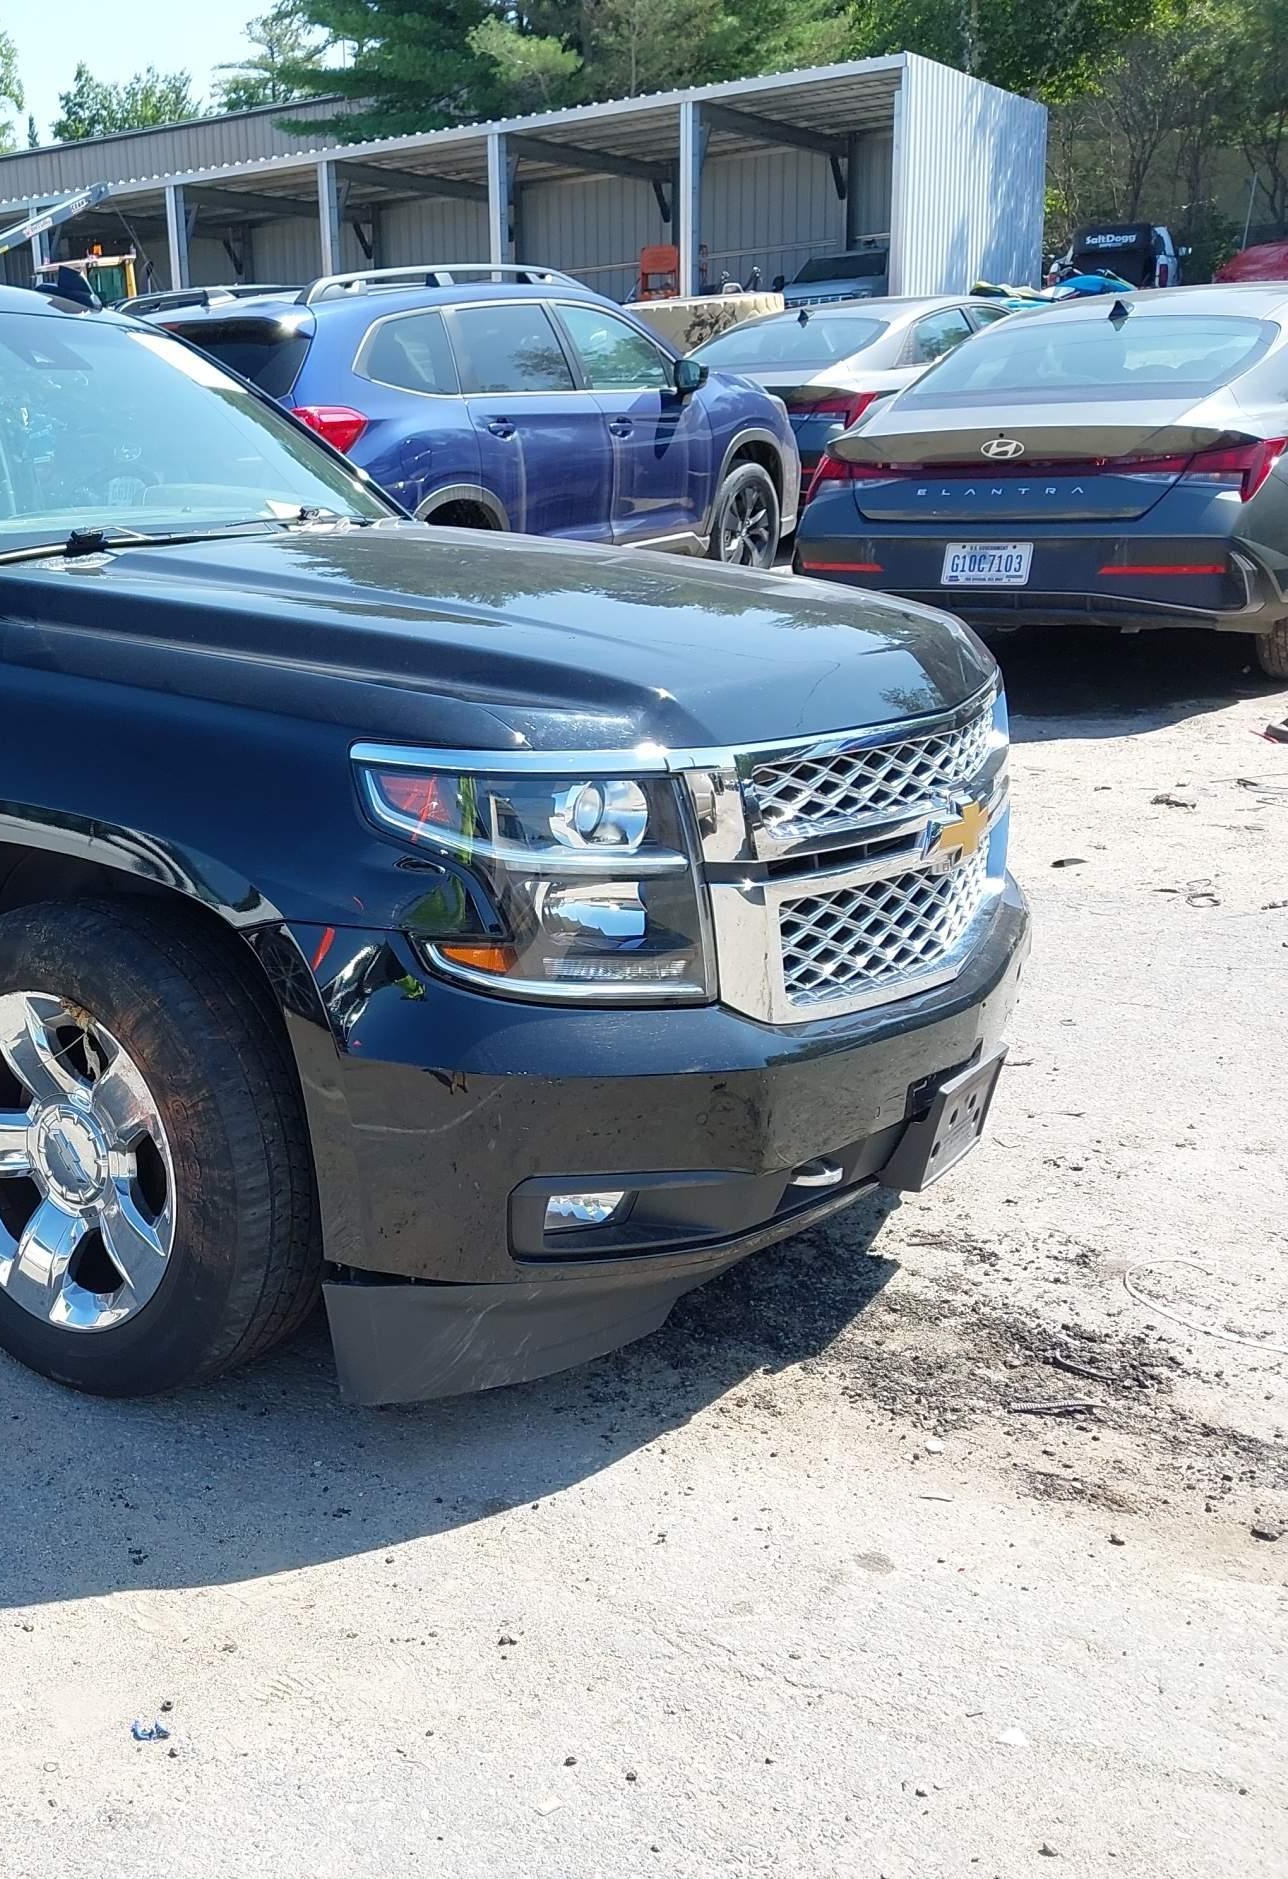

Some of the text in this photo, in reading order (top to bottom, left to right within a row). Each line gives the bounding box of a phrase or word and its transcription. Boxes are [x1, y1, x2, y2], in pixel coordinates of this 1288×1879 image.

[1085, 234, 1137, 245] SaltDogg
[916, 486, 1084, 496] ELANTRA
[951, 554, 1023, 573] G10C7103
